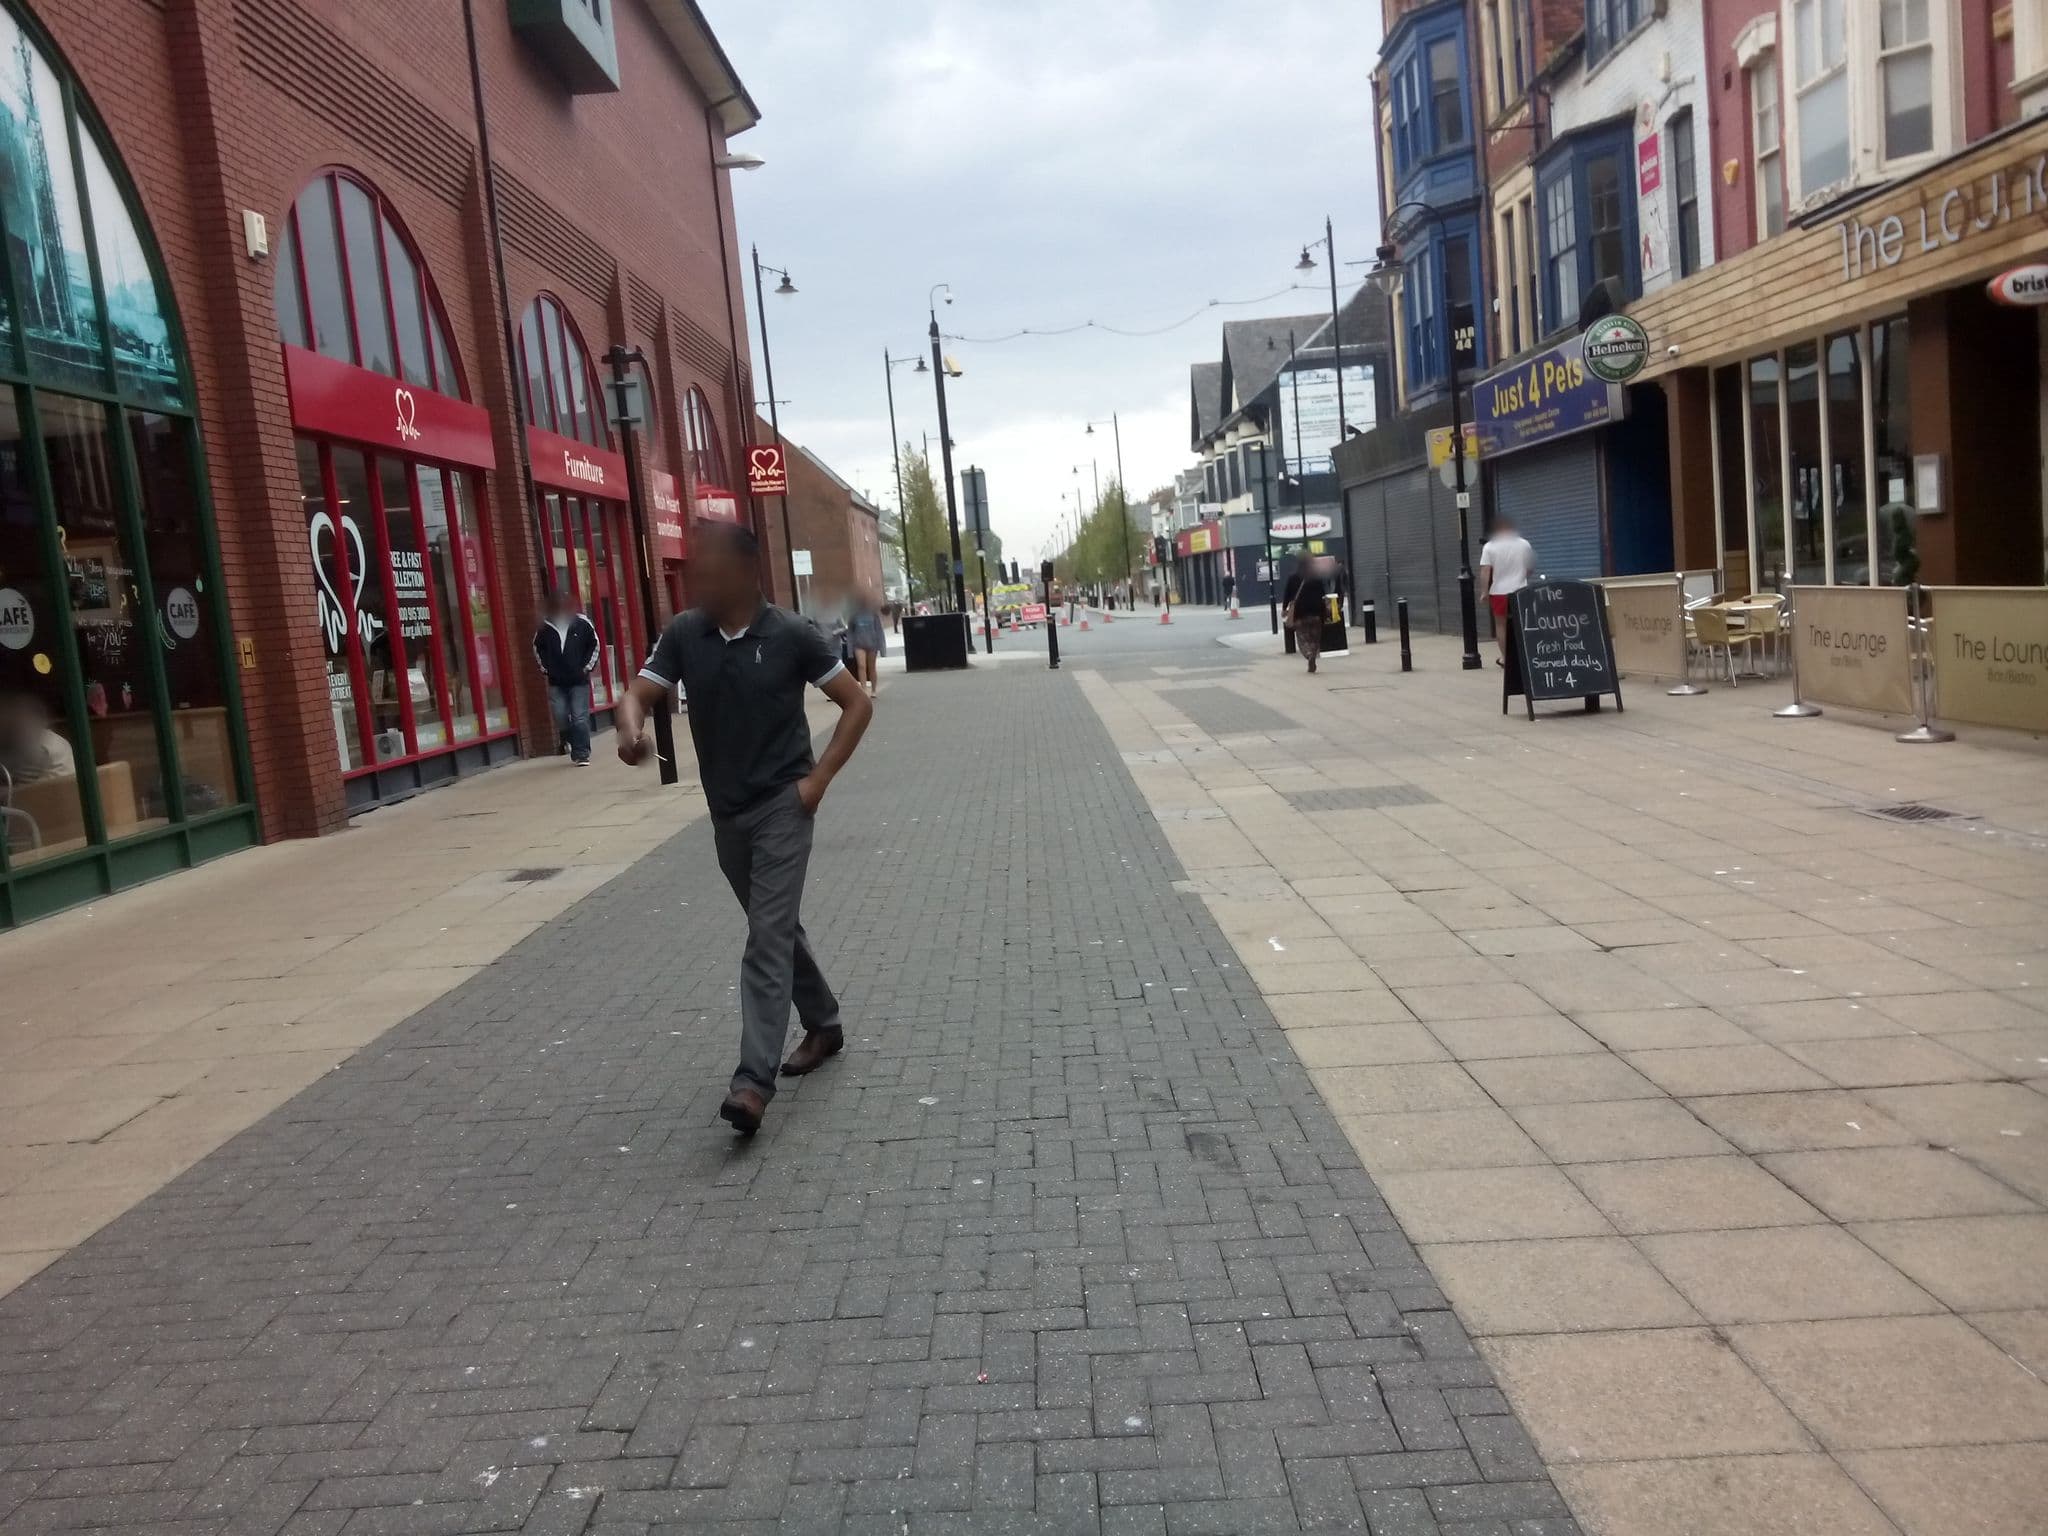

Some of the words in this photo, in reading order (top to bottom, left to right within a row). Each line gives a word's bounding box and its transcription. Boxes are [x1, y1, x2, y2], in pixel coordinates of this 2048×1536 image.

[1838, 214, 1904, 281] The
[1591, 341, 1644, 356] Heineken
[1492, 376, 1524, 418] Just
[1528, 363, 1541, 408] 4
[1544, 355, 1584, 398] Pets
[564, 450, 604, 485] Furniture
[407, 552, 422, 568] FAST
[393, 570, 425, 587] OLLECTION
[1535, 587, 1564, 602] The
[1524, 606, 1590, 638] Lounge
[1536, 640, 1561, 655] Fresh
[1563, 639, 1585, 651] Food
[1808, 624, 1832, 649] The
[1834, 628, 1887, 658] Lounge
[1953, 633, 1985, 661] The
[243, 643, 255, 666] H
[1532, 655, 1568, 669] Served
[1571, 653, 1603, 671] daily
